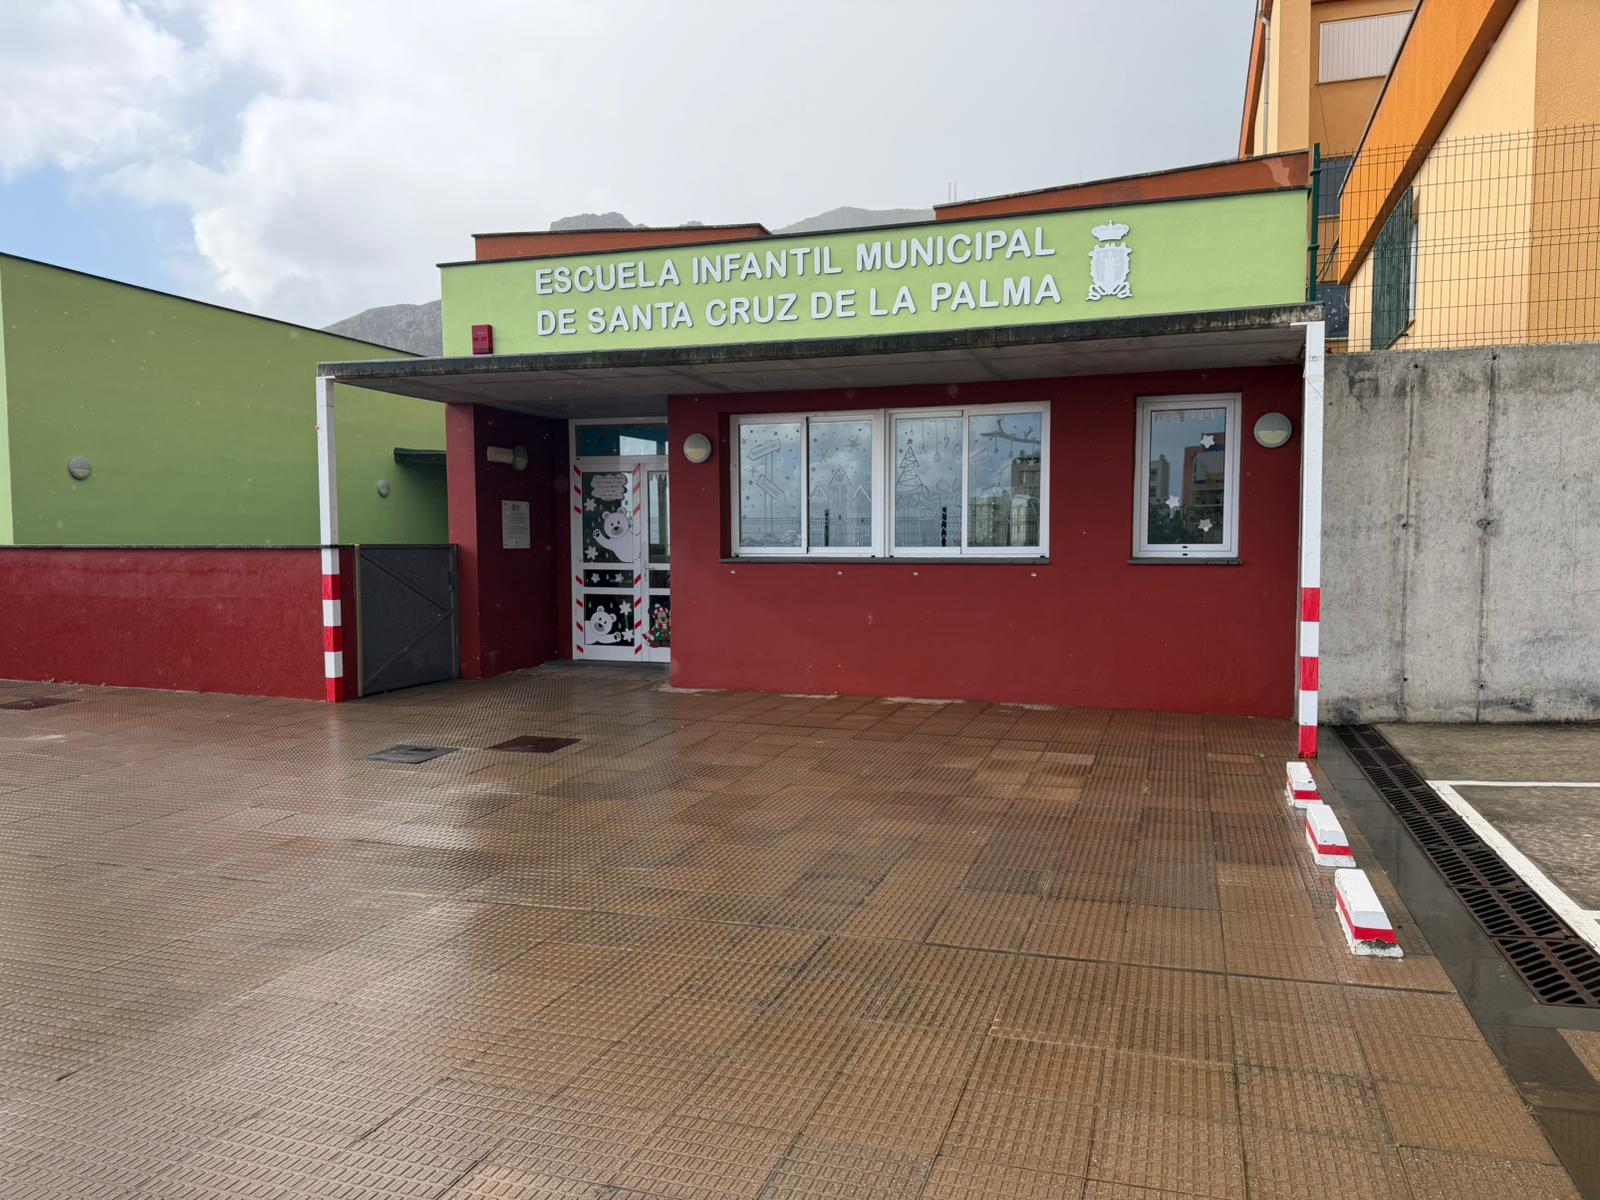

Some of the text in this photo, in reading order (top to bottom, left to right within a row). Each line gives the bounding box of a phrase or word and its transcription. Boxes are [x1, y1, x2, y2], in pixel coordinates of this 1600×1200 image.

[536, 226, 1056, 294] ESCUELA INFANTIL MUNICIPAL
[537, 273, 1061, 336] DE SANTA CRUZ DE LA PALMA
